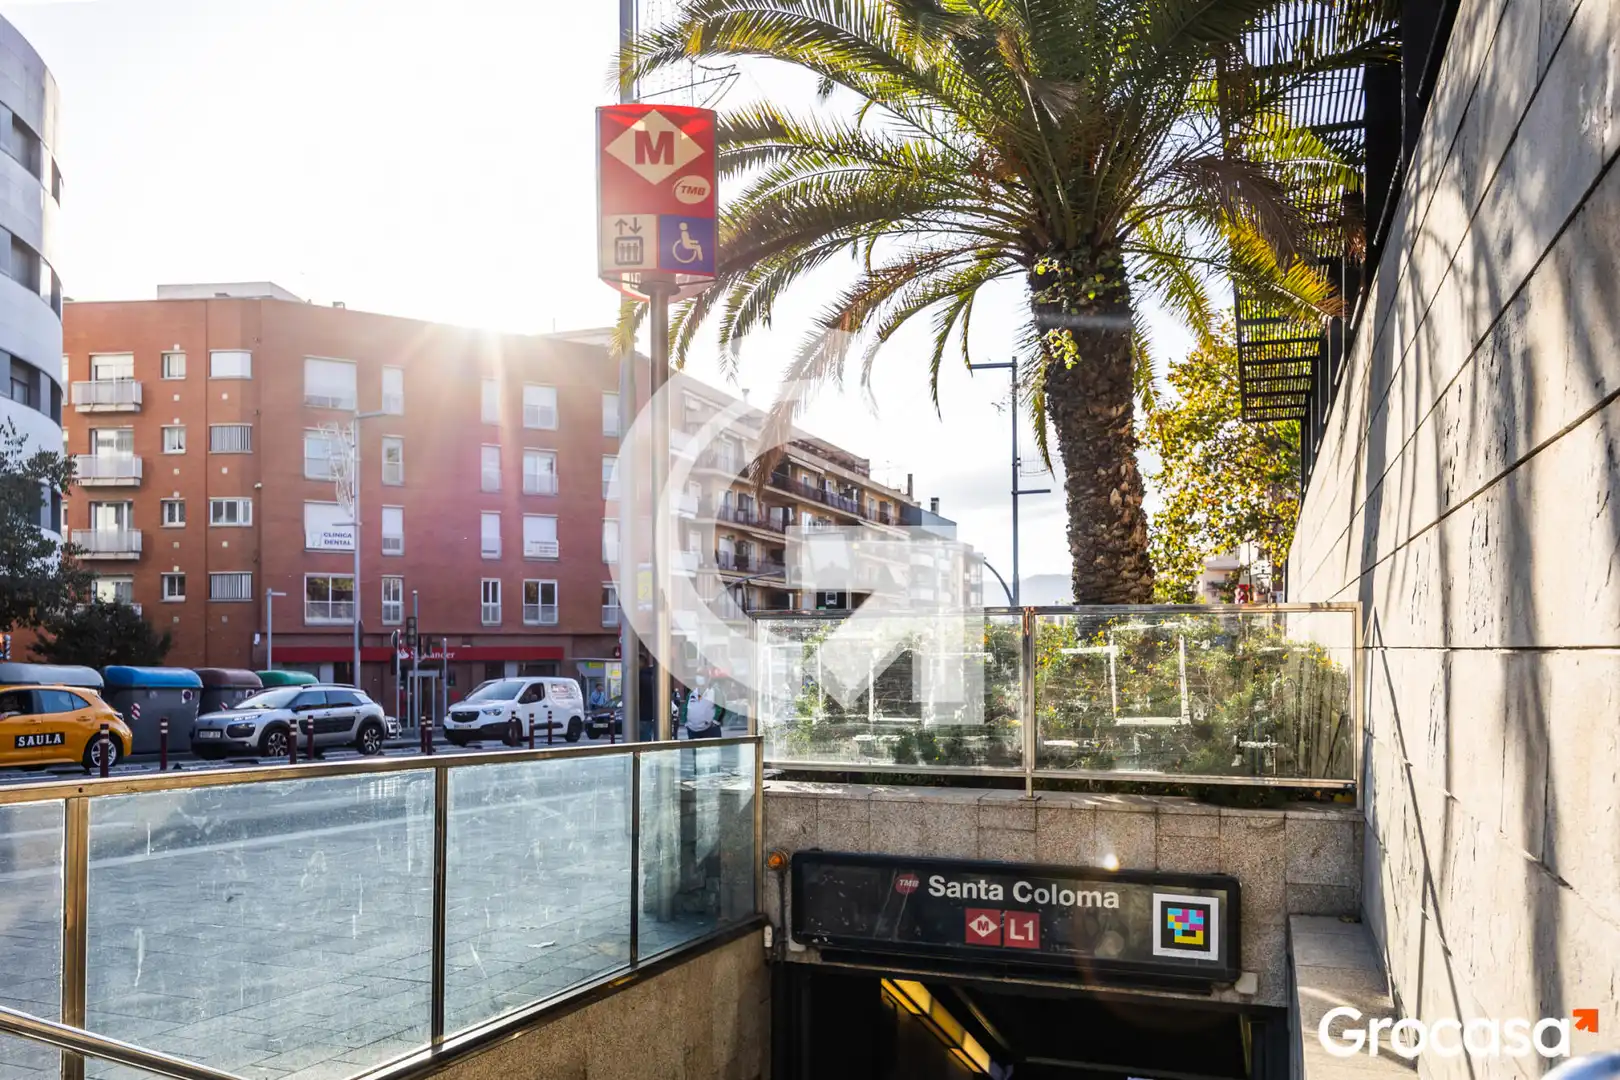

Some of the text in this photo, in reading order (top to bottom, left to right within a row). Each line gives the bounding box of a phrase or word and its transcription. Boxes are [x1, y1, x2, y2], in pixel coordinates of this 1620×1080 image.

[634, 130, 675, 166] M
[679, 184, 706, 197] TMB
[17, 733, 62, 747] SAULA
[897, 878, 920, 889] TMB
[927, 874, 1120, 910] Santa Coloma
[975, 917, 1036, 943] M L1
